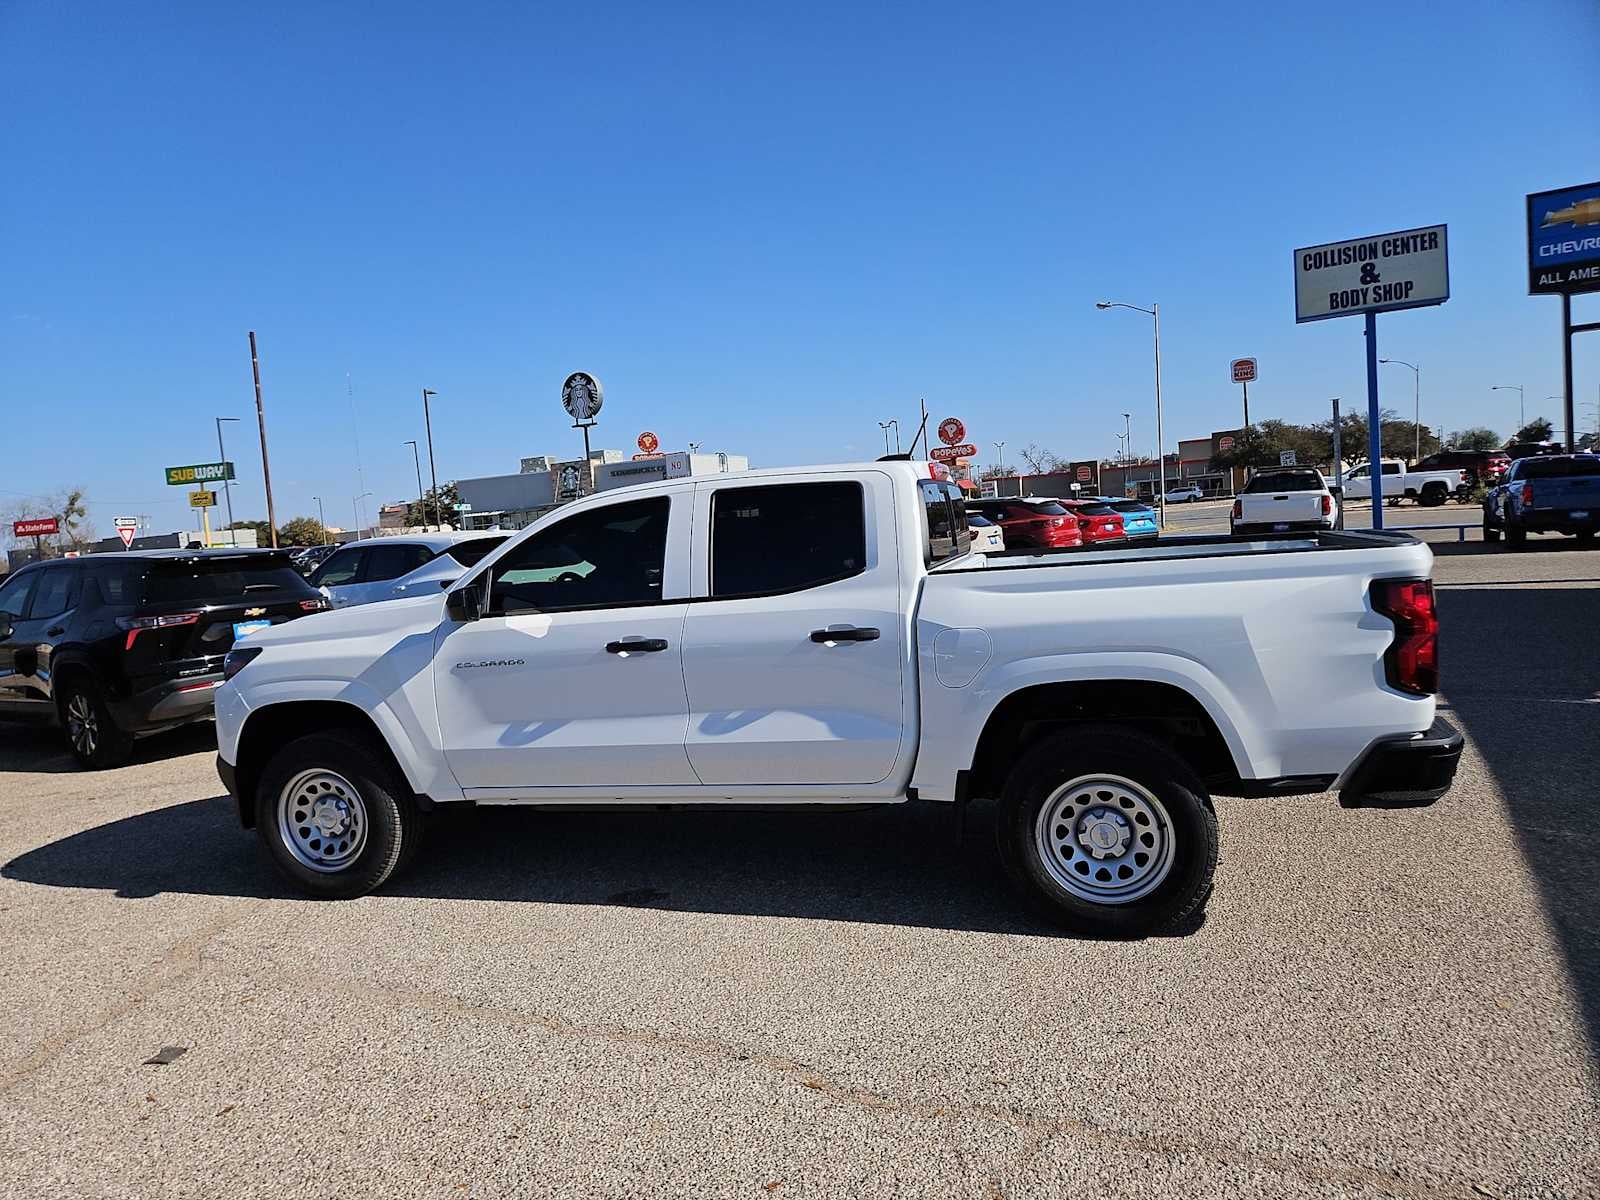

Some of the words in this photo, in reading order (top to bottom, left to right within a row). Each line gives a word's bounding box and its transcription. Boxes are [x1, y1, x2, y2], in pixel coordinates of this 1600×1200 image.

[1303, 242, 1378, 271] COLLISION
[1382, 231, 1439, 258] CENTER
[1360, 262, 1381, 285] &
[1539, 272, 1565, 285] ALL
[1329, 287, 1370, 310] BODY
[1372, 281, 1414, 304] SHOP
[170, 465, 224, 481] SUBWAY
[456, 659, 525, 669] COLORADO
